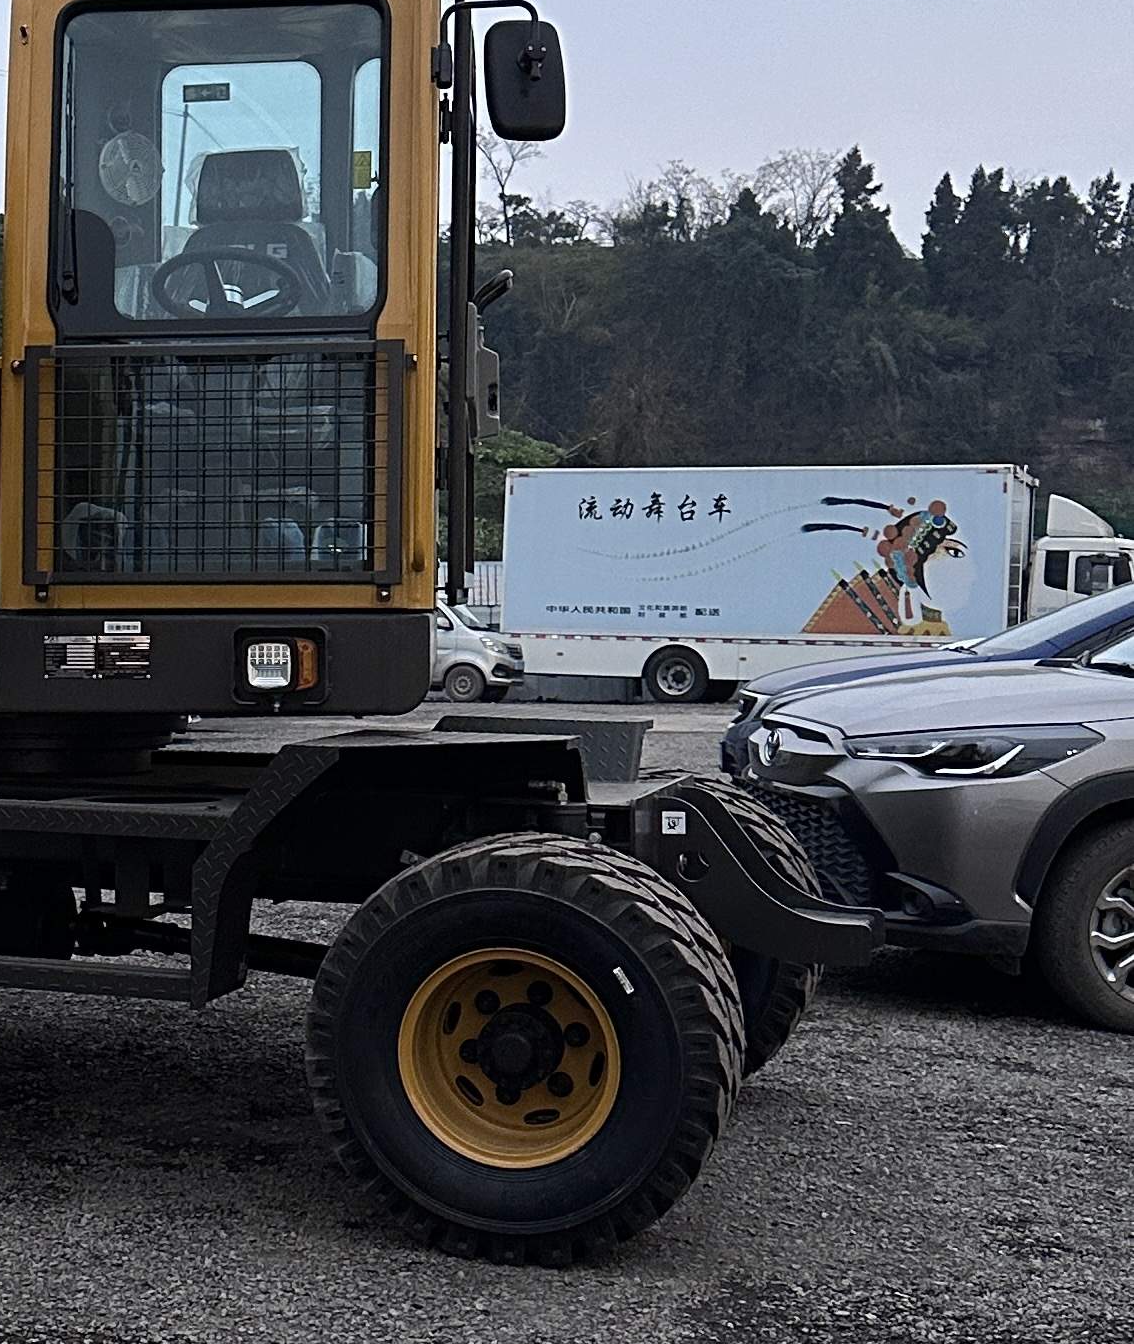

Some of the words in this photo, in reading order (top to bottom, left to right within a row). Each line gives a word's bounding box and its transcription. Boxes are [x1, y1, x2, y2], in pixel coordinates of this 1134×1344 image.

[578, 491, 731, 523] 流动舞台车
[546, 605, 631, 614] 中华人民共和国
